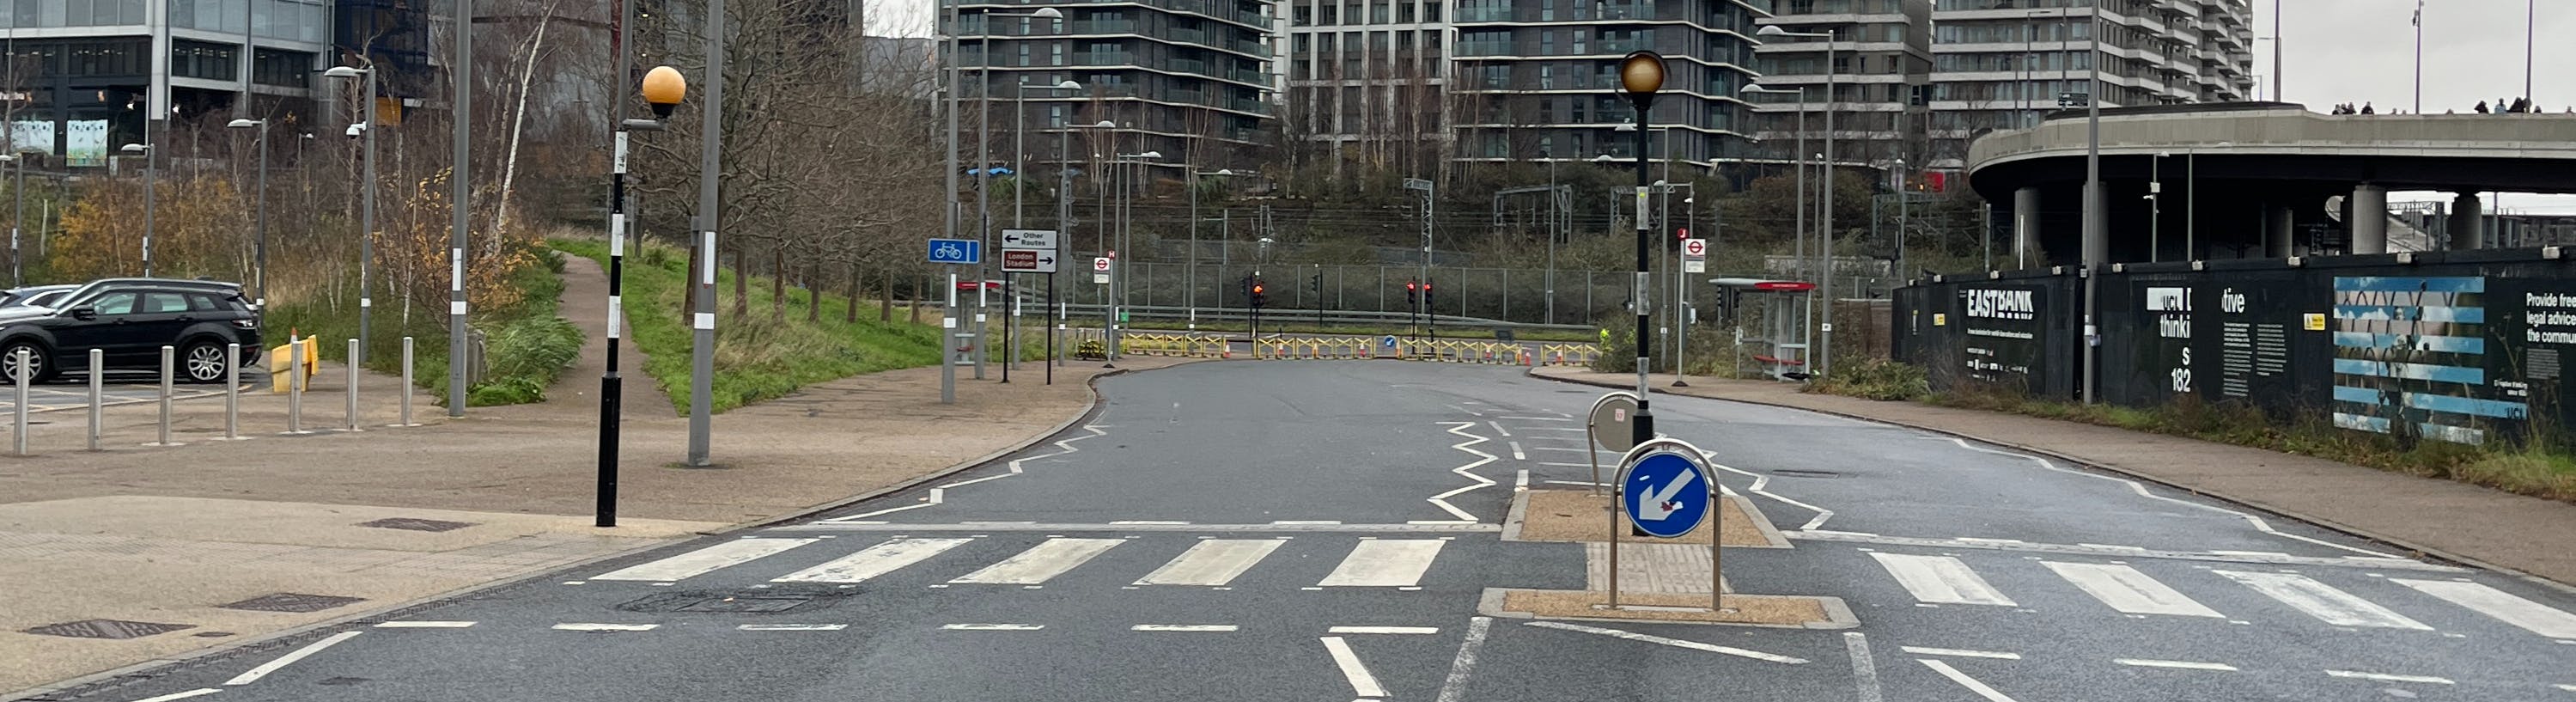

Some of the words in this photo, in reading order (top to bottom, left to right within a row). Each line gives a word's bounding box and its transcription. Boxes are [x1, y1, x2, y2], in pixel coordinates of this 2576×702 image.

[2221, 287, 2245, 314] tive
[2526, 292, 2558, 307] Provide
[2559, 293, 2576, 308] free
[2526, 310, 2547, 327] legal
[2548, 310, 2576, 326] advice
[2527, 327, 2541, 343] the
[2542, 331, 2576, 345] commu
[2171, 368, 2191, 393] 182
